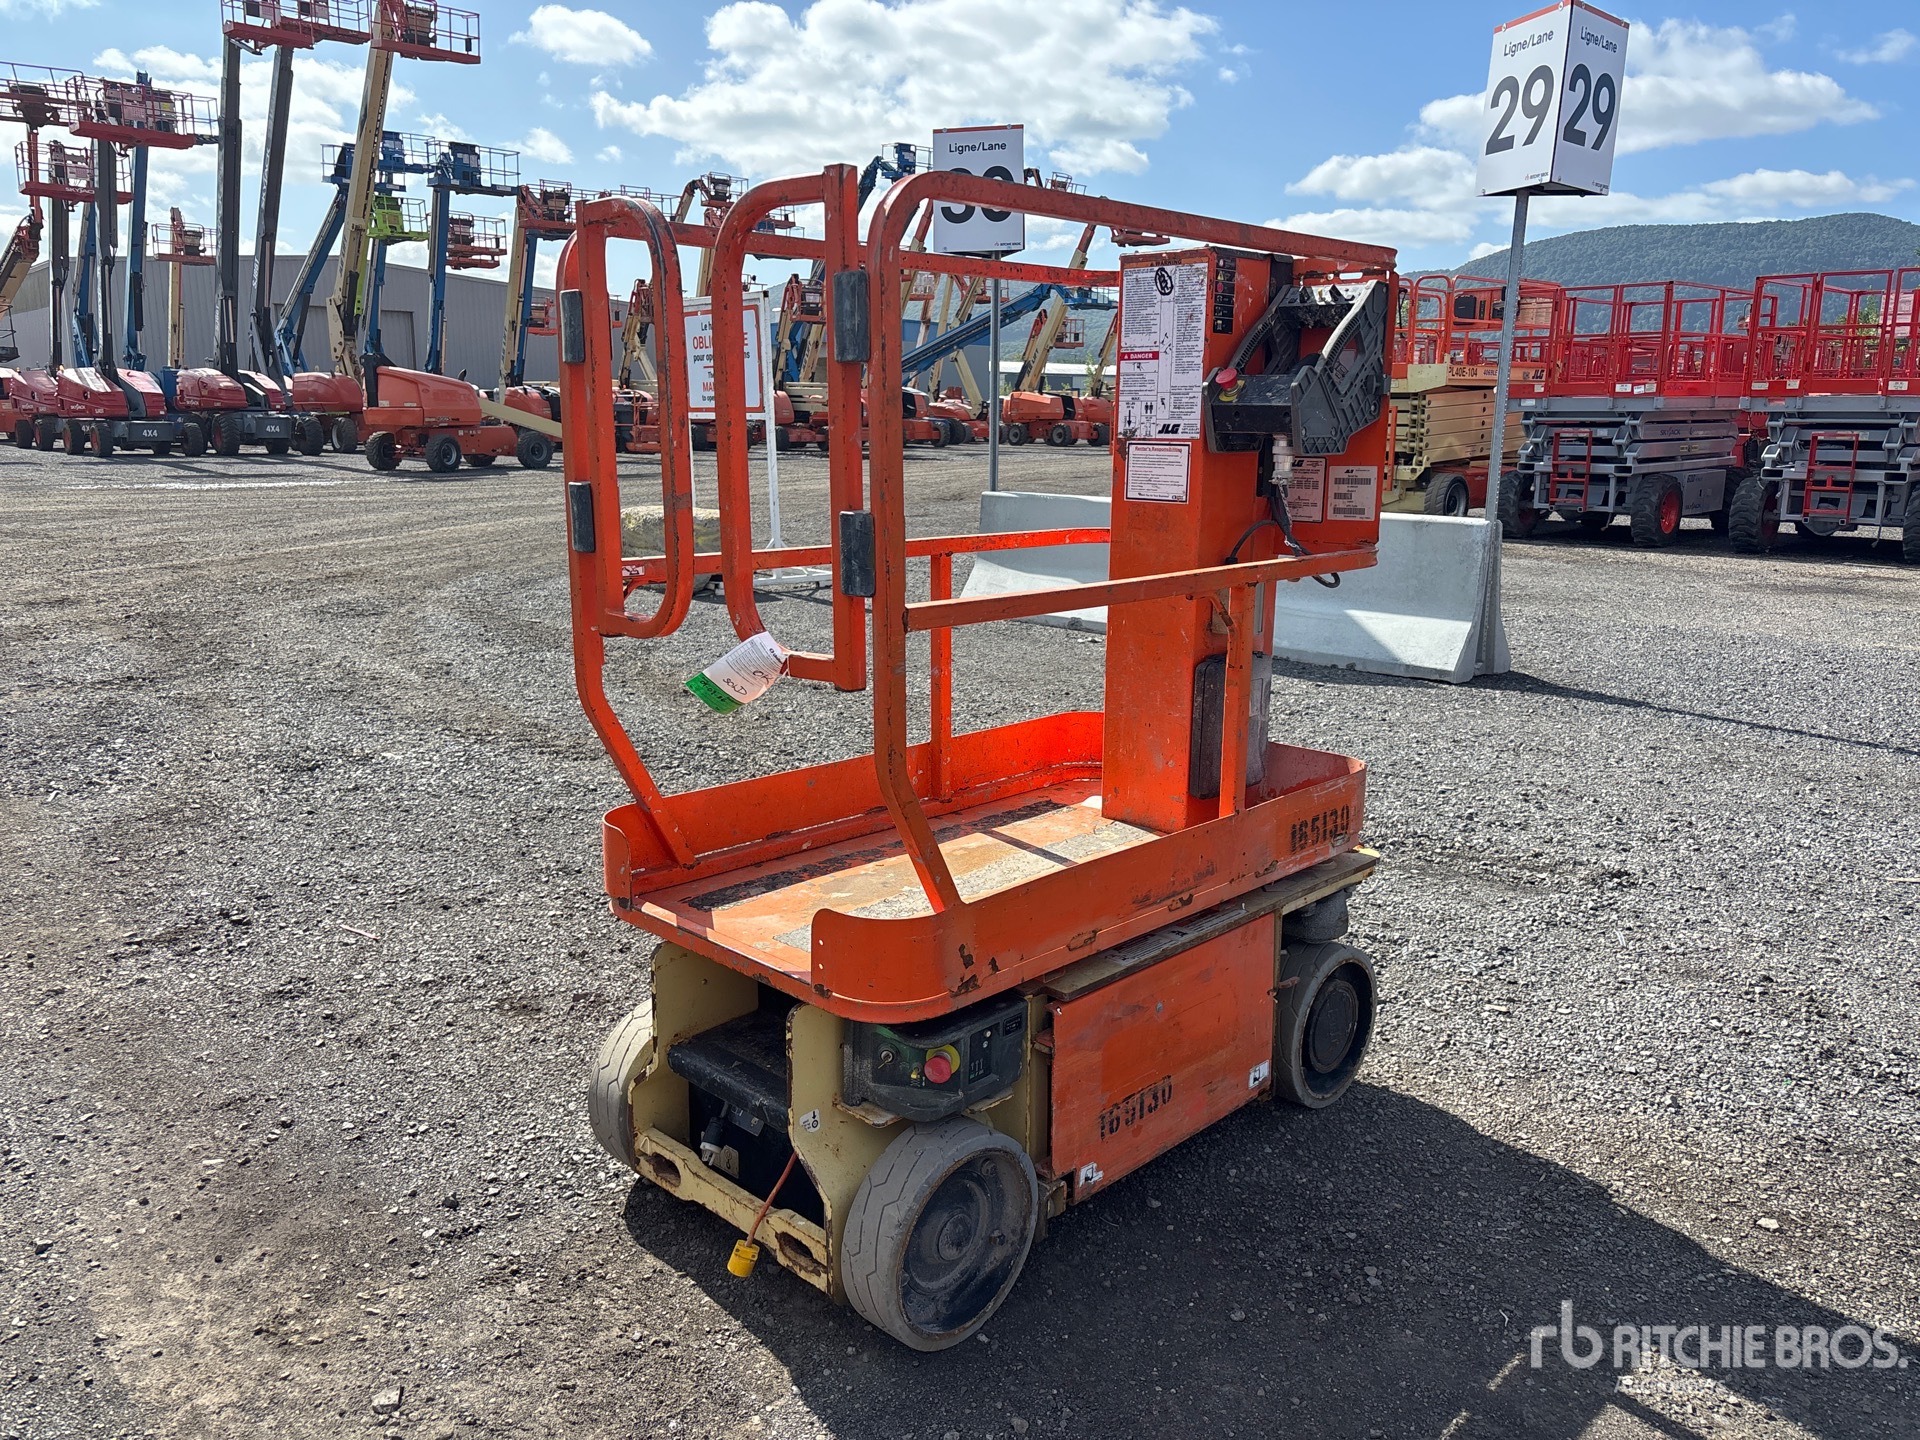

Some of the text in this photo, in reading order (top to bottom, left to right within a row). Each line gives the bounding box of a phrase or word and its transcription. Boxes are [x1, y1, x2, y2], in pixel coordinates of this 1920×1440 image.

[1503, 29, 1554, 57] Ligne/Lane
[1580, 26, 1618, 53] Ligne/Lane
[1485, 64, 1554, 156] 29
[1562, 63, 1616, 151] 29
[949, 141, 1007, 155] Ligne/Lane
[693, 355, 705, 364] pour
[1532, 369, 1545, 379] JLG
[143, 429, 158, 437] 4X4
[265, 425, 280, 433] 4X4
[1157, 424, 1181, 434] JLG
[723, 677, 748, 696] SOLD
